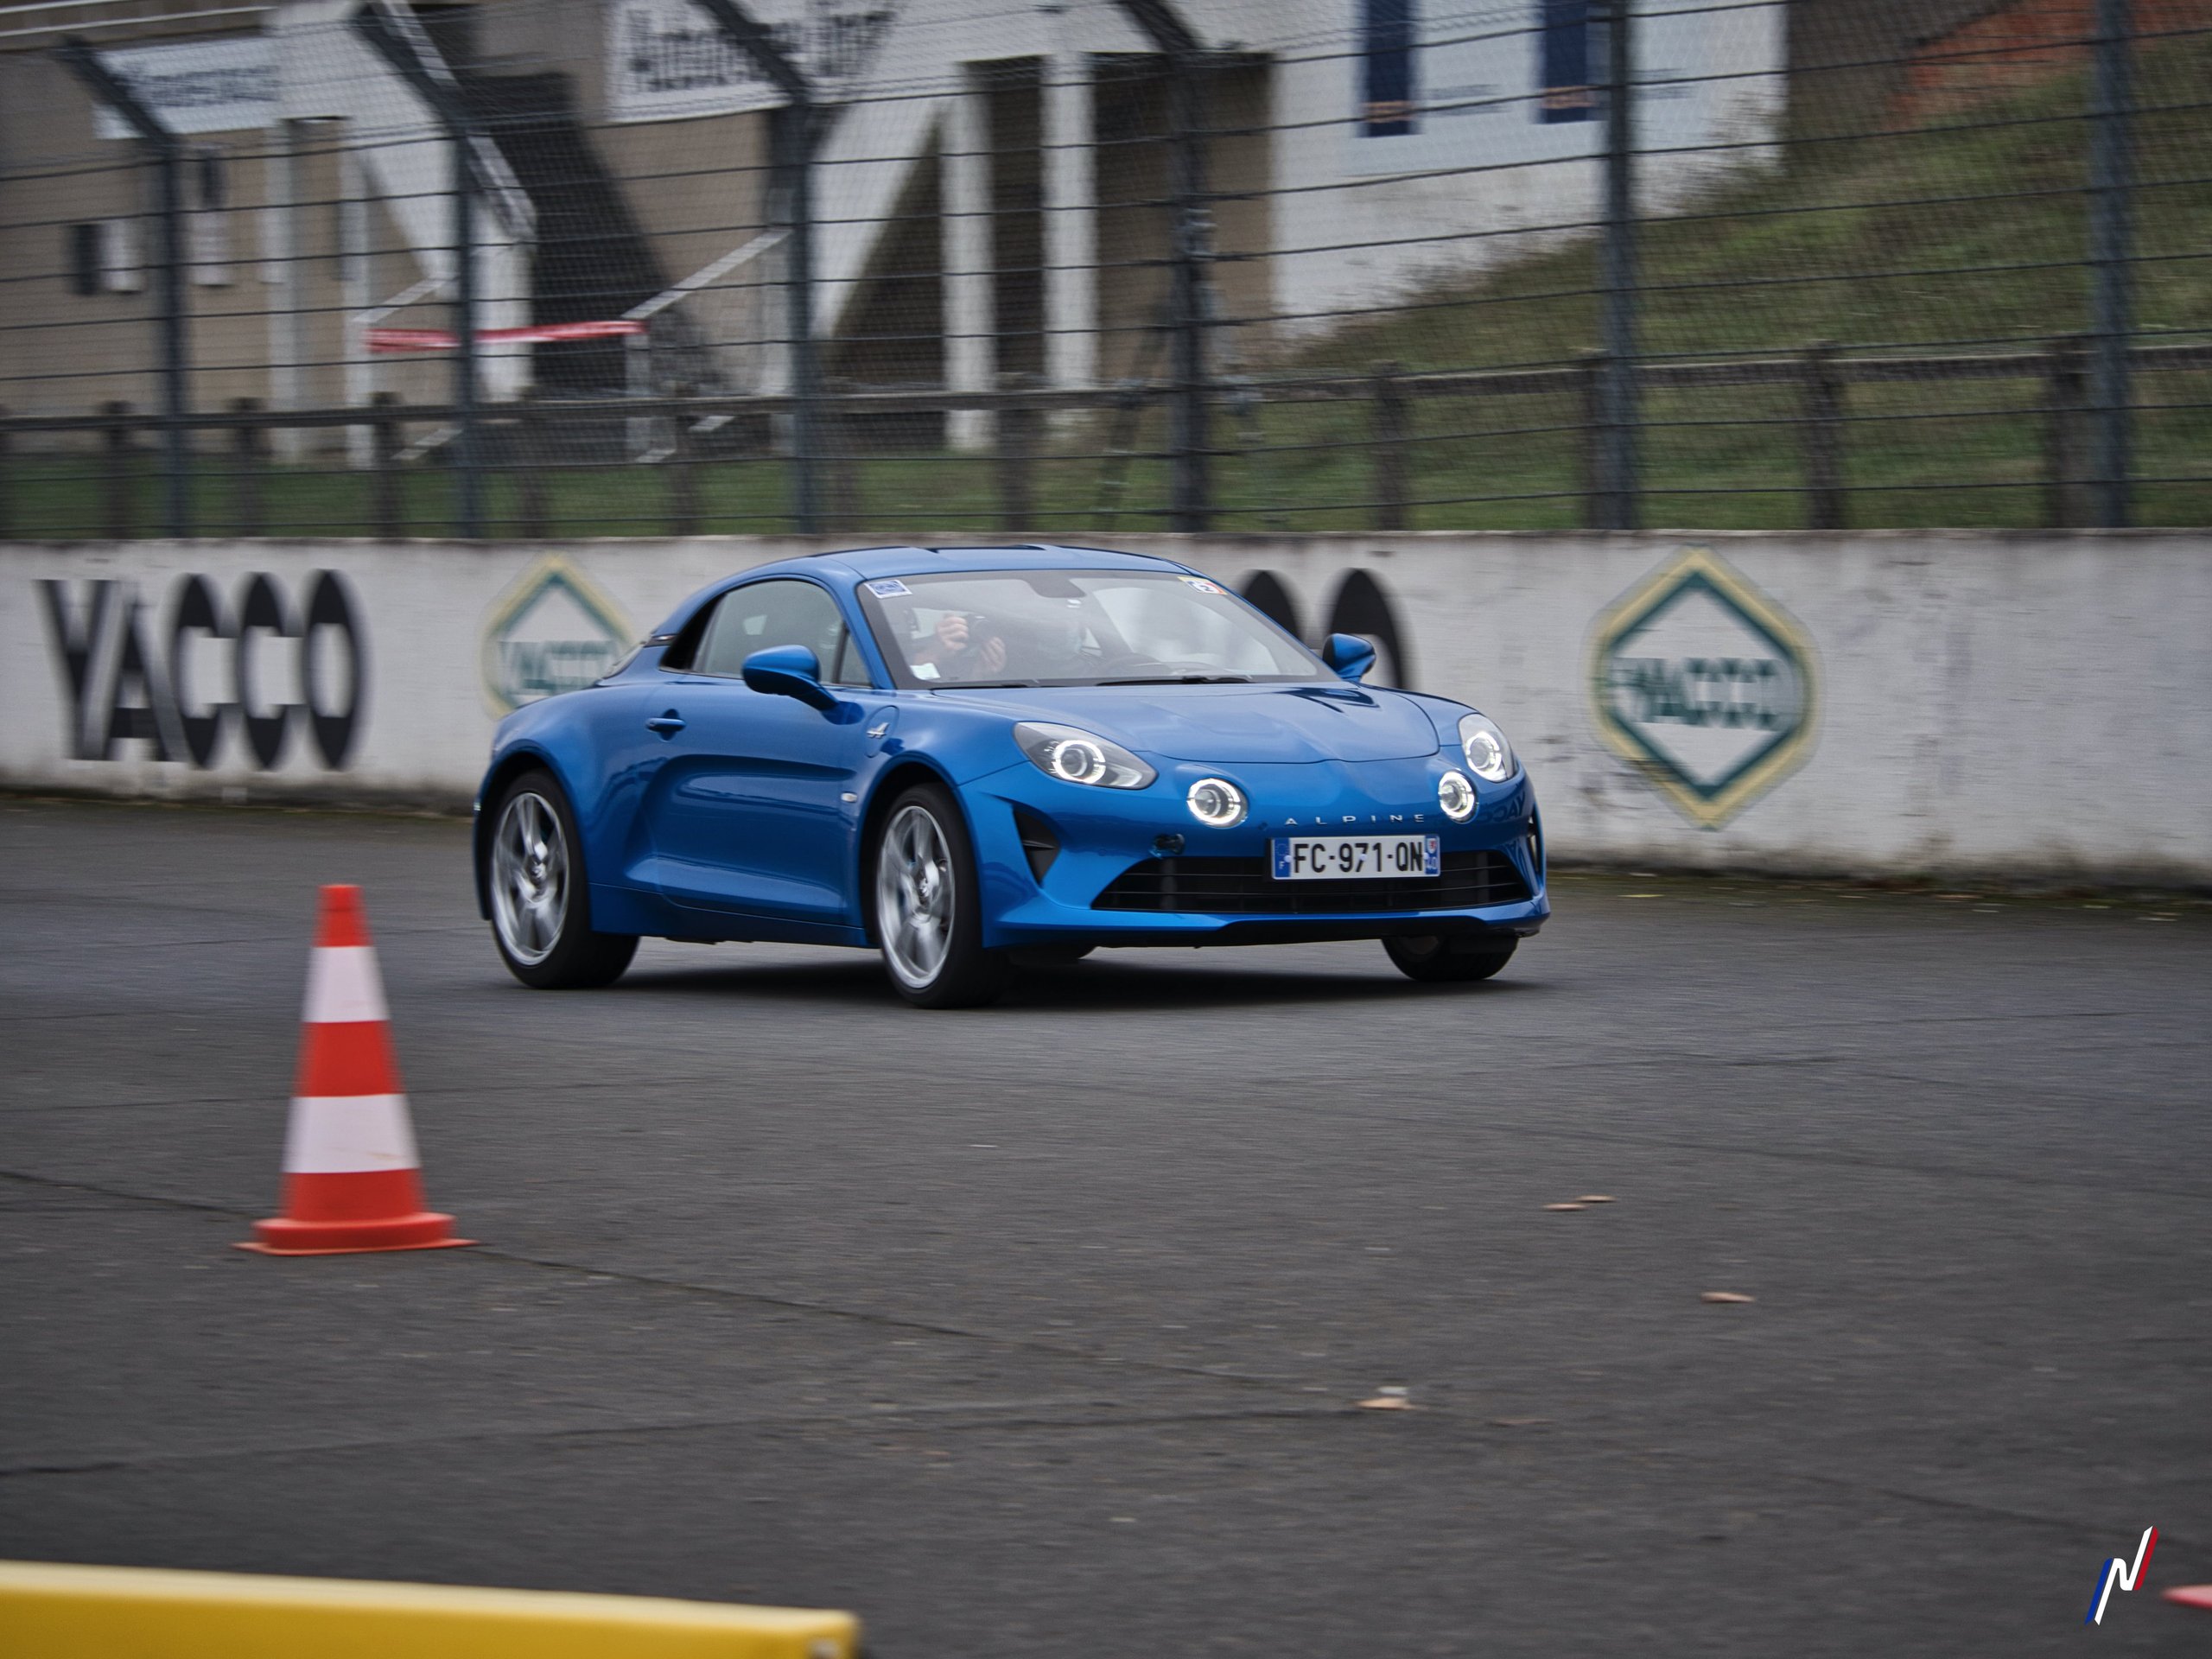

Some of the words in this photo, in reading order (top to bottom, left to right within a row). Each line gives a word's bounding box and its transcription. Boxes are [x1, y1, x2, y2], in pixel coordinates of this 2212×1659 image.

[35, 569, 372, 771] YACCO
[1284, 814, 1425, 825] ALPINE
[1294, 841, 1423, 874] FC-971-QN
